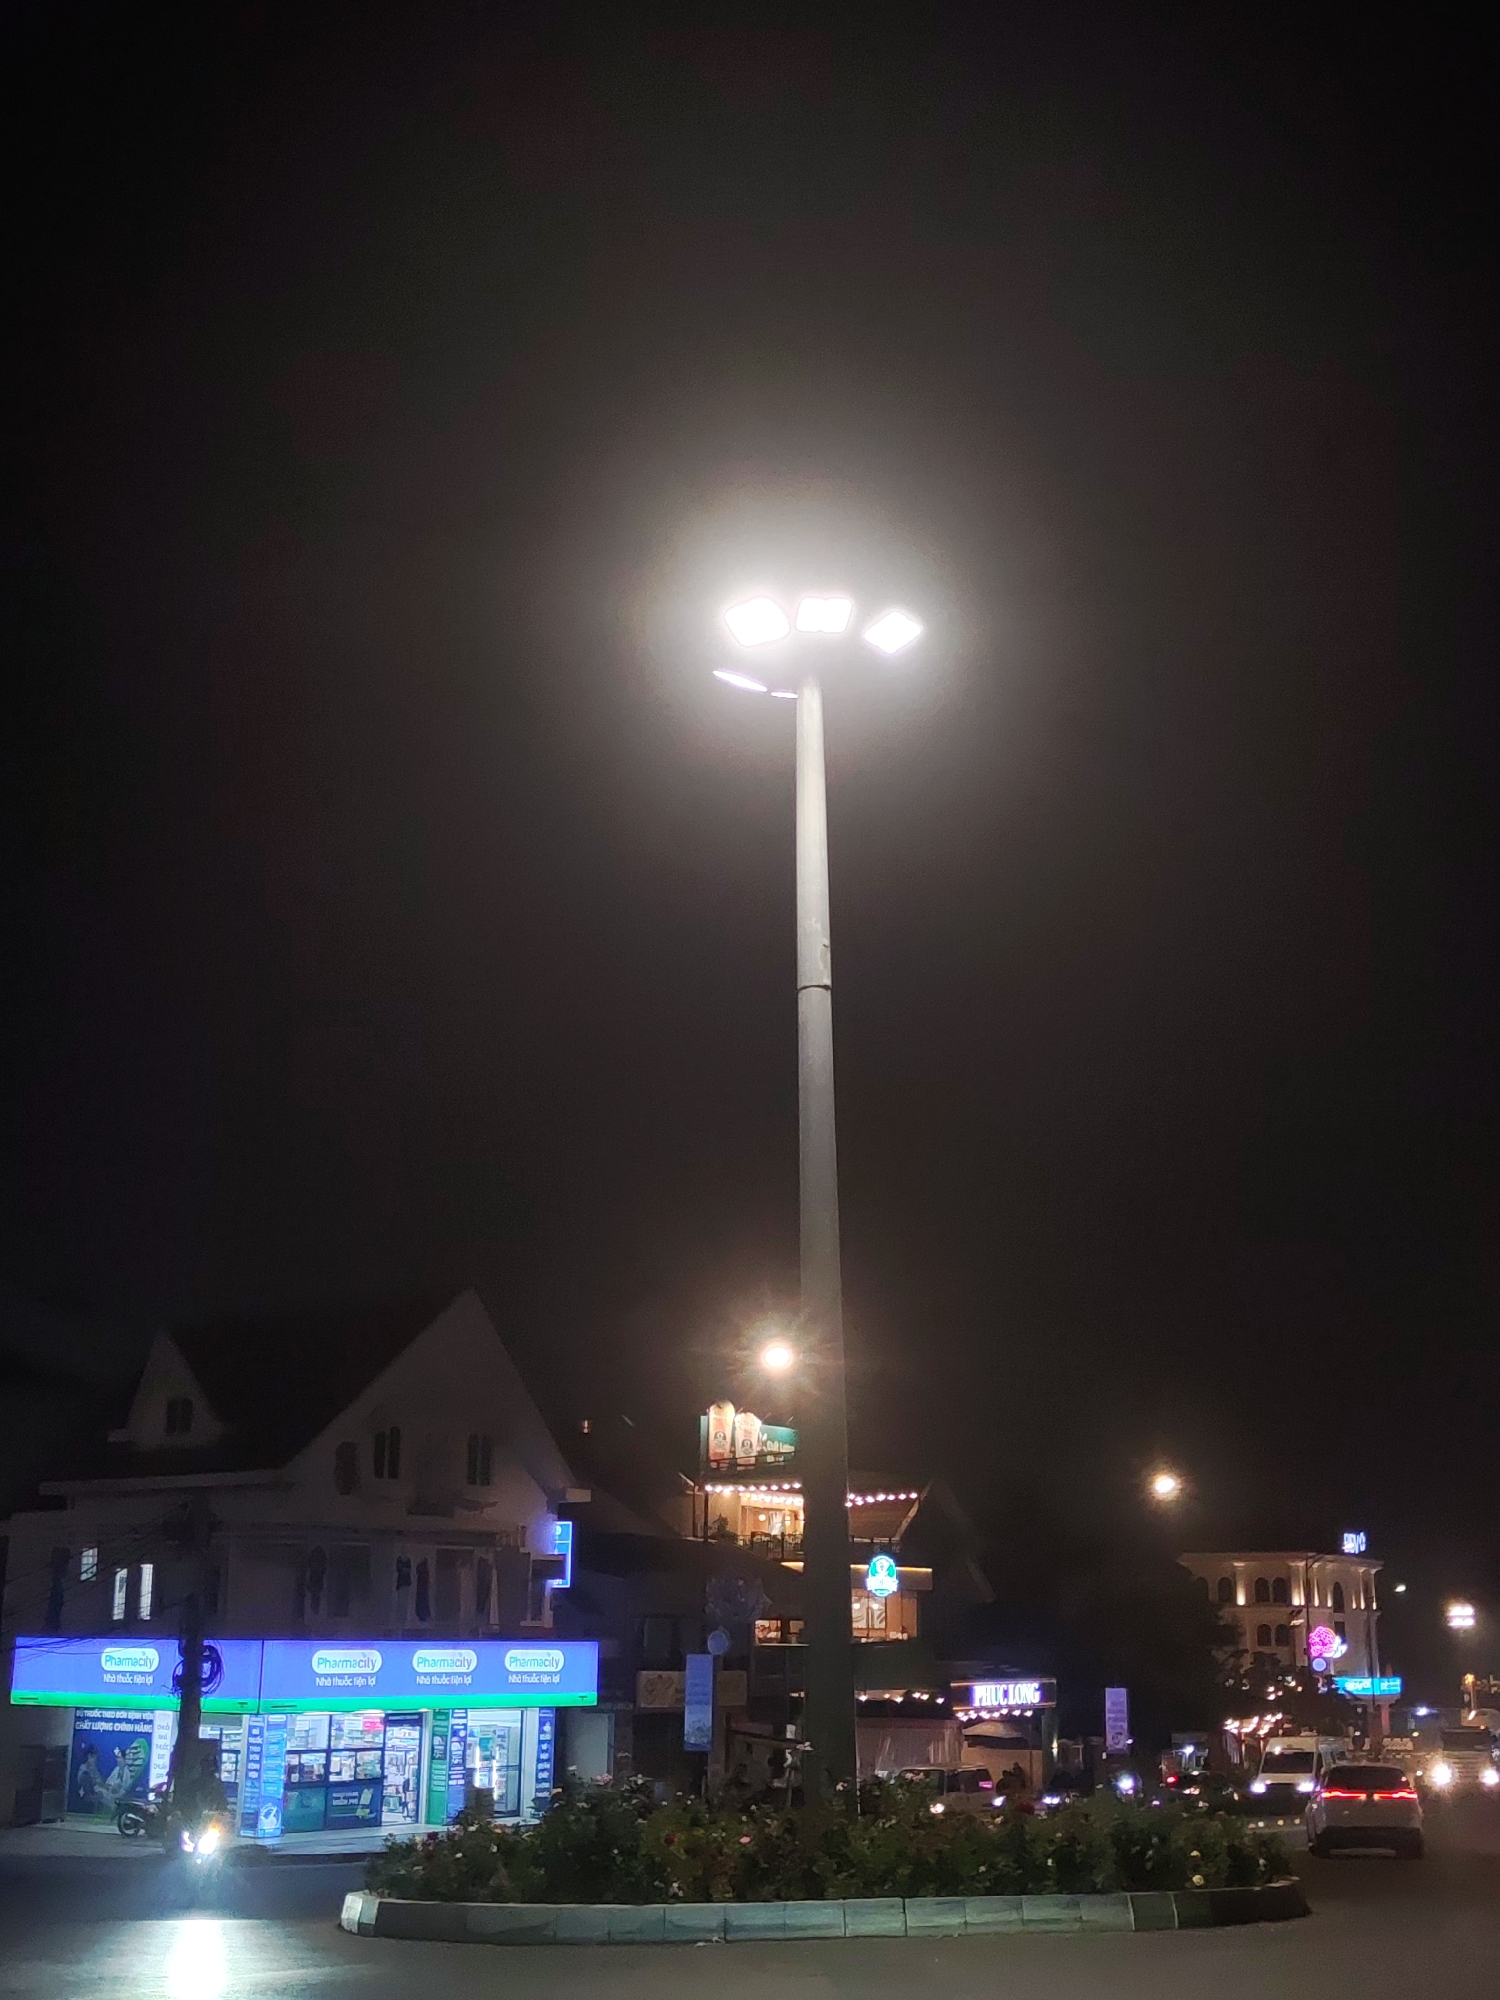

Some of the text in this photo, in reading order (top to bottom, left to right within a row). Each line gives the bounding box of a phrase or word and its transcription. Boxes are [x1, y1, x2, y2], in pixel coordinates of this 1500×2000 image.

[104, 1653, 155, 1670] Pharmacity
[317, 1653, 377, 1671] Pharmacity
[416, 1653, 472, 1670] Pharmacity
[509, 1653, 560, 1669] Pharmacity
[1007, 1683, 1041, 1705] LONG
